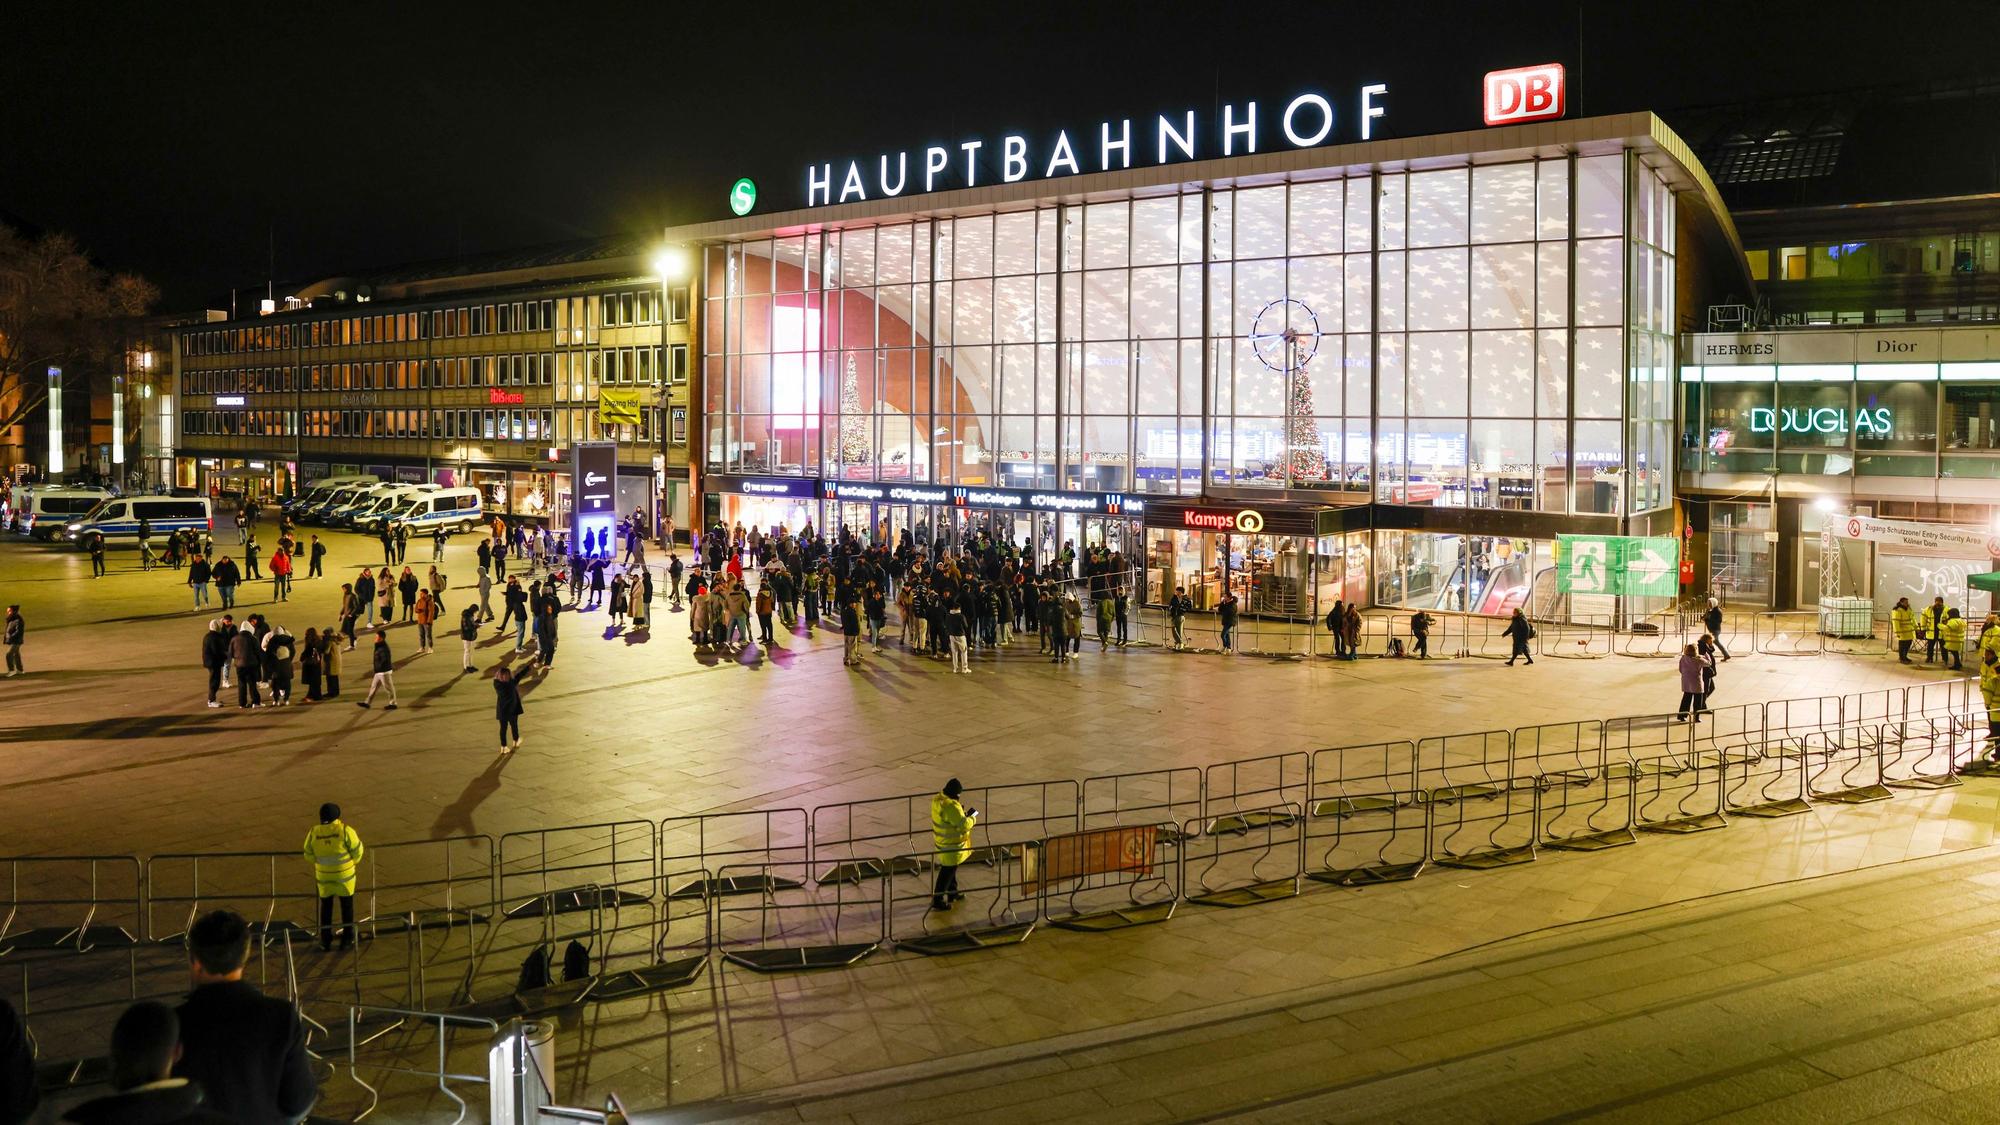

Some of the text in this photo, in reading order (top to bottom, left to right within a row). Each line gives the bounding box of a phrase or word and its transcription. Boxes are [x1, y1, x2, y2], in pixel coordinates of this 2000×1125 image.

[1494, 74, 1553, 116] DB
[807, 83, 1389, 207] HAUPTBAHNHOF
[735, 181, 753, 212] S
[1706, 343, 1774, 356] HERMÈS
[1877, 340, 1918, 353] Dior
[490, 388, 524, 404] ibis HOTEL
[604, 399, 627, 409] Zugang
[1751, 407, 1892, 433] DOUGLAS
[1575, 452, 1646, 463] STARBUS
[838, 485, 883, 499] NetCologne
[968, 492, 1022, 507] NetCologne
[1184, 510, 1235, 530] Kamps
[1865, 523, 1886, 533] Zugang
[1921, 530, 1939, 541] Entry
[1939, 532, 1966, 544] Security
[1966, 536, 1982, 545] Area
[1904, 536, 1938, 548] Kölner Dom
